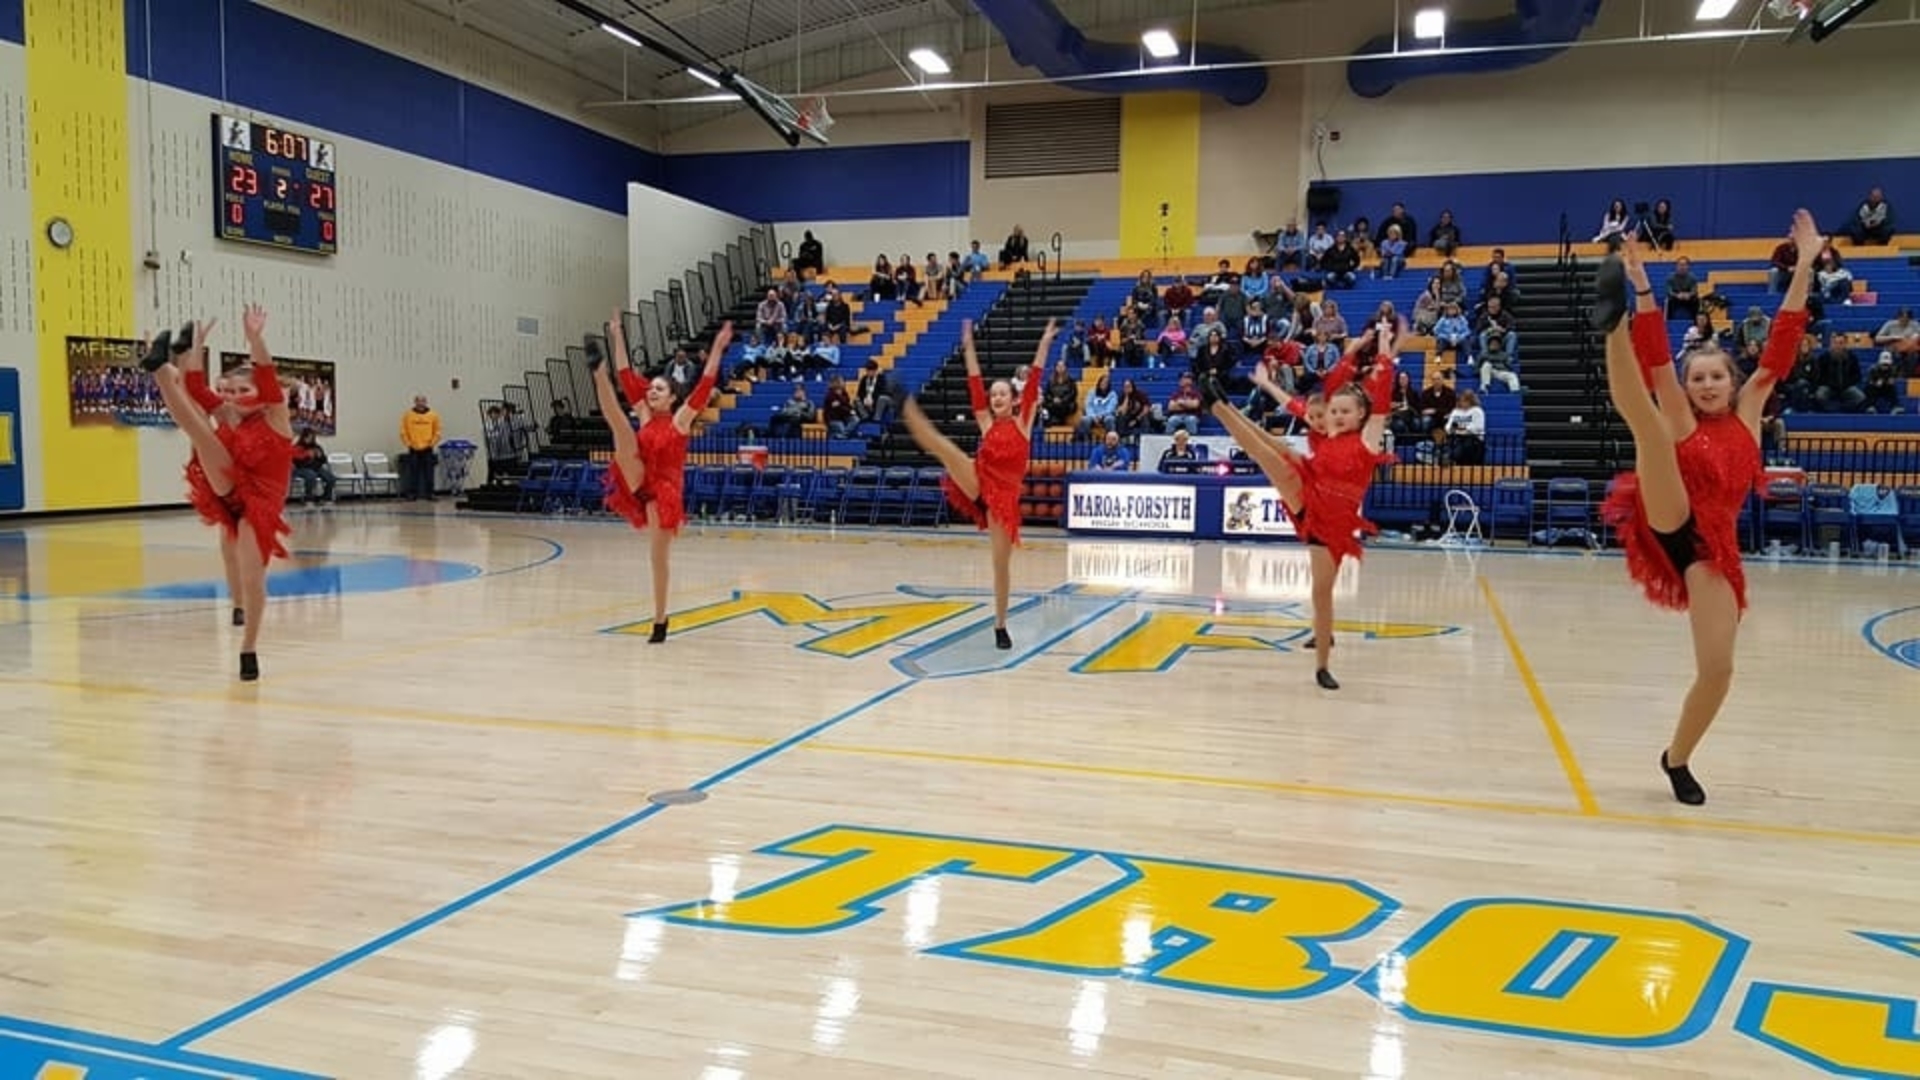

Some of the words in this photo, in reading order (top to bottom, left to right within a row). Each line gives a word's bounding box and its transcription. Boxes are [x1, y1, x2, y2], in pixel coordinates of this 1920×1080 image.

[231, 166, 257, 194] 23
[276, 179, 287, 199] 2
[310, 184, 333, 209] 27
[231, 203, 243, 223] 0
[323, 221, 333, 240] 0
[69, 341, 131, 360] MFHS
[1072, 494, 1192, 520] MAROA-FORSYTH
